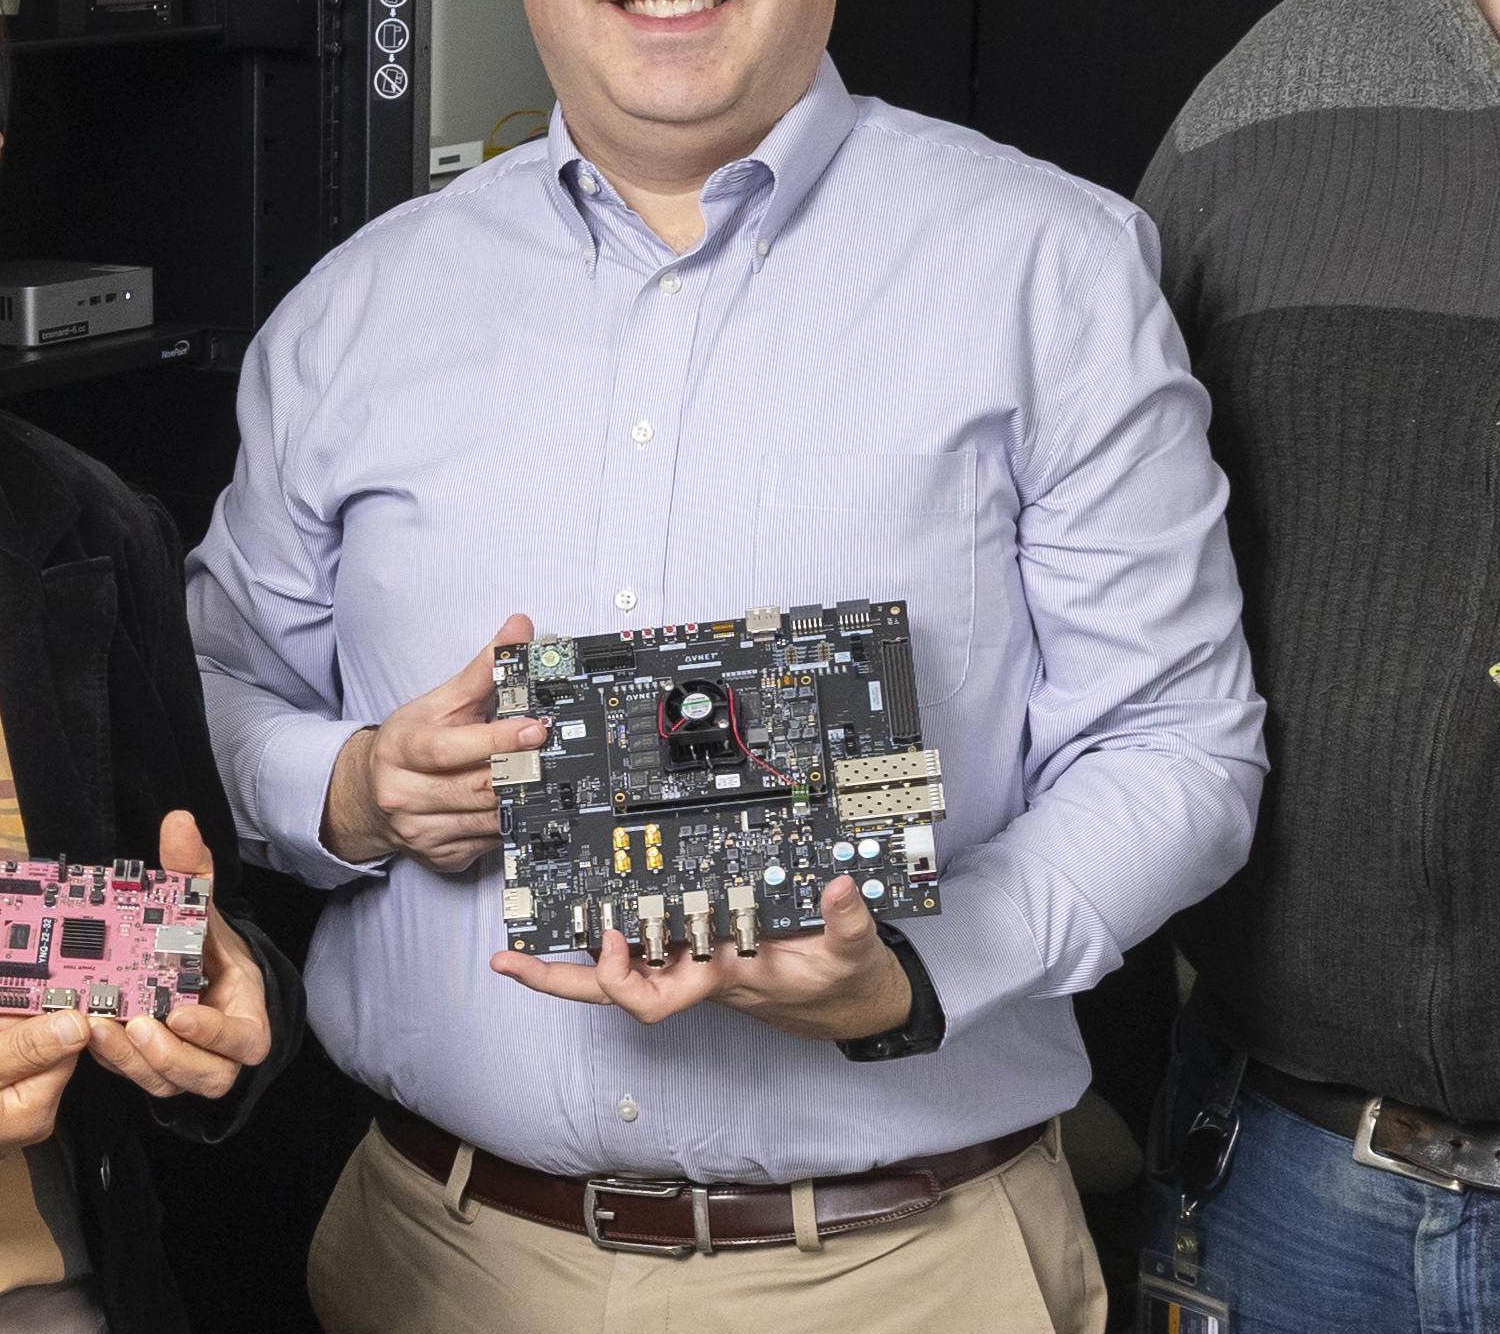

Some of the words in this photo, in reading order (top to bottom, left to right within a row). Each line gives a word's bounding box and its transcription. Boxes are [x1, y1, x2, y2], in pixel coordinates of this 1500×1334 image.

[685, 652, 718, 663] AVNET
[626, 691, 659, 701] AVNET
[38, 918, 53, 964] YNQ-Z2-32
